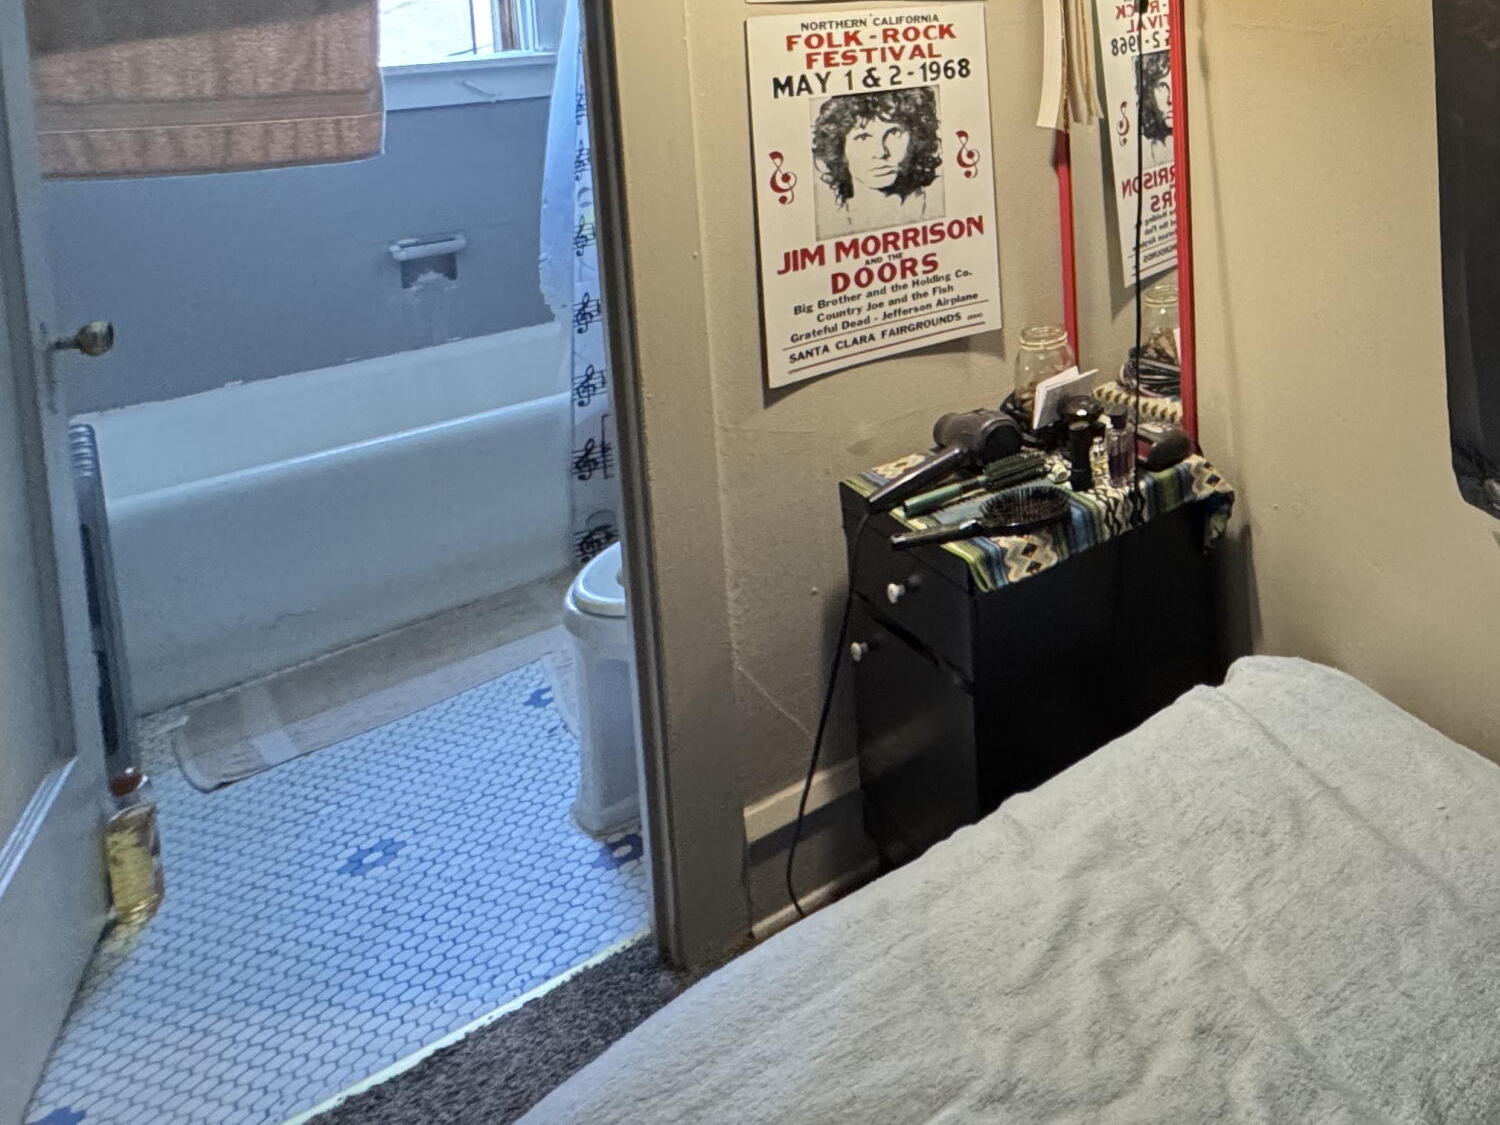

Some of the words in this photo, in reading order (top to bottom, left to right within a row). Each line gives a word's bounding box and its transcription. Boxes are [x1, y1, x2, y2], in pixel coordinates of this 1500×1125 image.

[800, 17, 867, 33] NORTHERN
[872, 13, 940, 27] CALIFORNIA
[805, 43, 942, 70] FESTIVAL
[772, 71, 831, 99] MAY
[844, 70, 852, 91] 1
[862, 67, 881, 89] &
[777, 244, 825, 276] JIM
[835, 215, 985, 263] MORRISON
[864, 256, 883, 266] AND
[888, 252, 903, 262] THE
[793, 302, 814, 316] Big
[817, 292, 862, 309] Brother
[866, 286, 887, 299] and
[891, 282, 909, 293] the
[912, 272, 951, 289] Holding
[955, 269, 973, 279] Co.
[830, 253, 939, 295] DOORS
[790, 323, 838, 344] Grateful
[841, 315, 871, 332] Dead
[882, 301, 933, 322] Jefferson
[935, 292, 979, 307] Airplane
[817, 305, 863, 323] Country
[867, 300, 884, 313] Joe
[888, 294, 908, 307] and
[911, 290, 929, 302] the
[932, 284, 954, 297] Fish
[788, 345, 830, 364] SANTA
[835, 332, 876, 351] CLARA
[881, 312, 962, 339] FAIRGROUNDS
